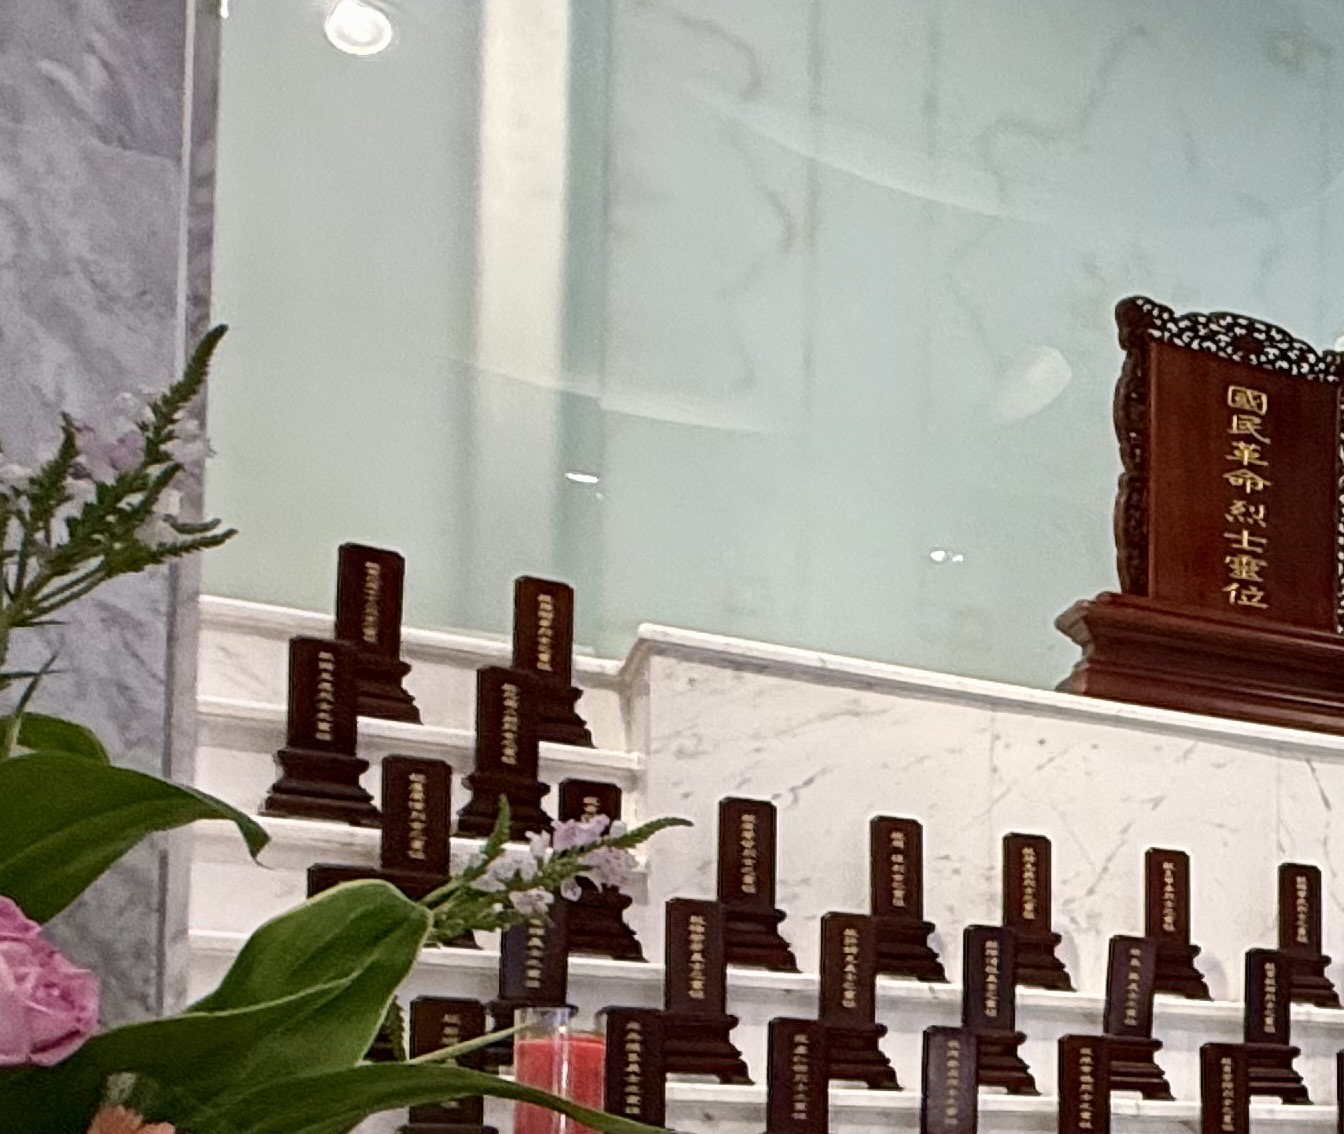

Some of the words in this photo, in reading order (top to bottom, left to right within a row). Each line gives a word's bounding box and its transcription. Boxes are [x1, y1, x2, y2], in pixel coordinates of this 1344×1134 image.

[1221, 385, 1273, 610] 國民革命烈士靈位
